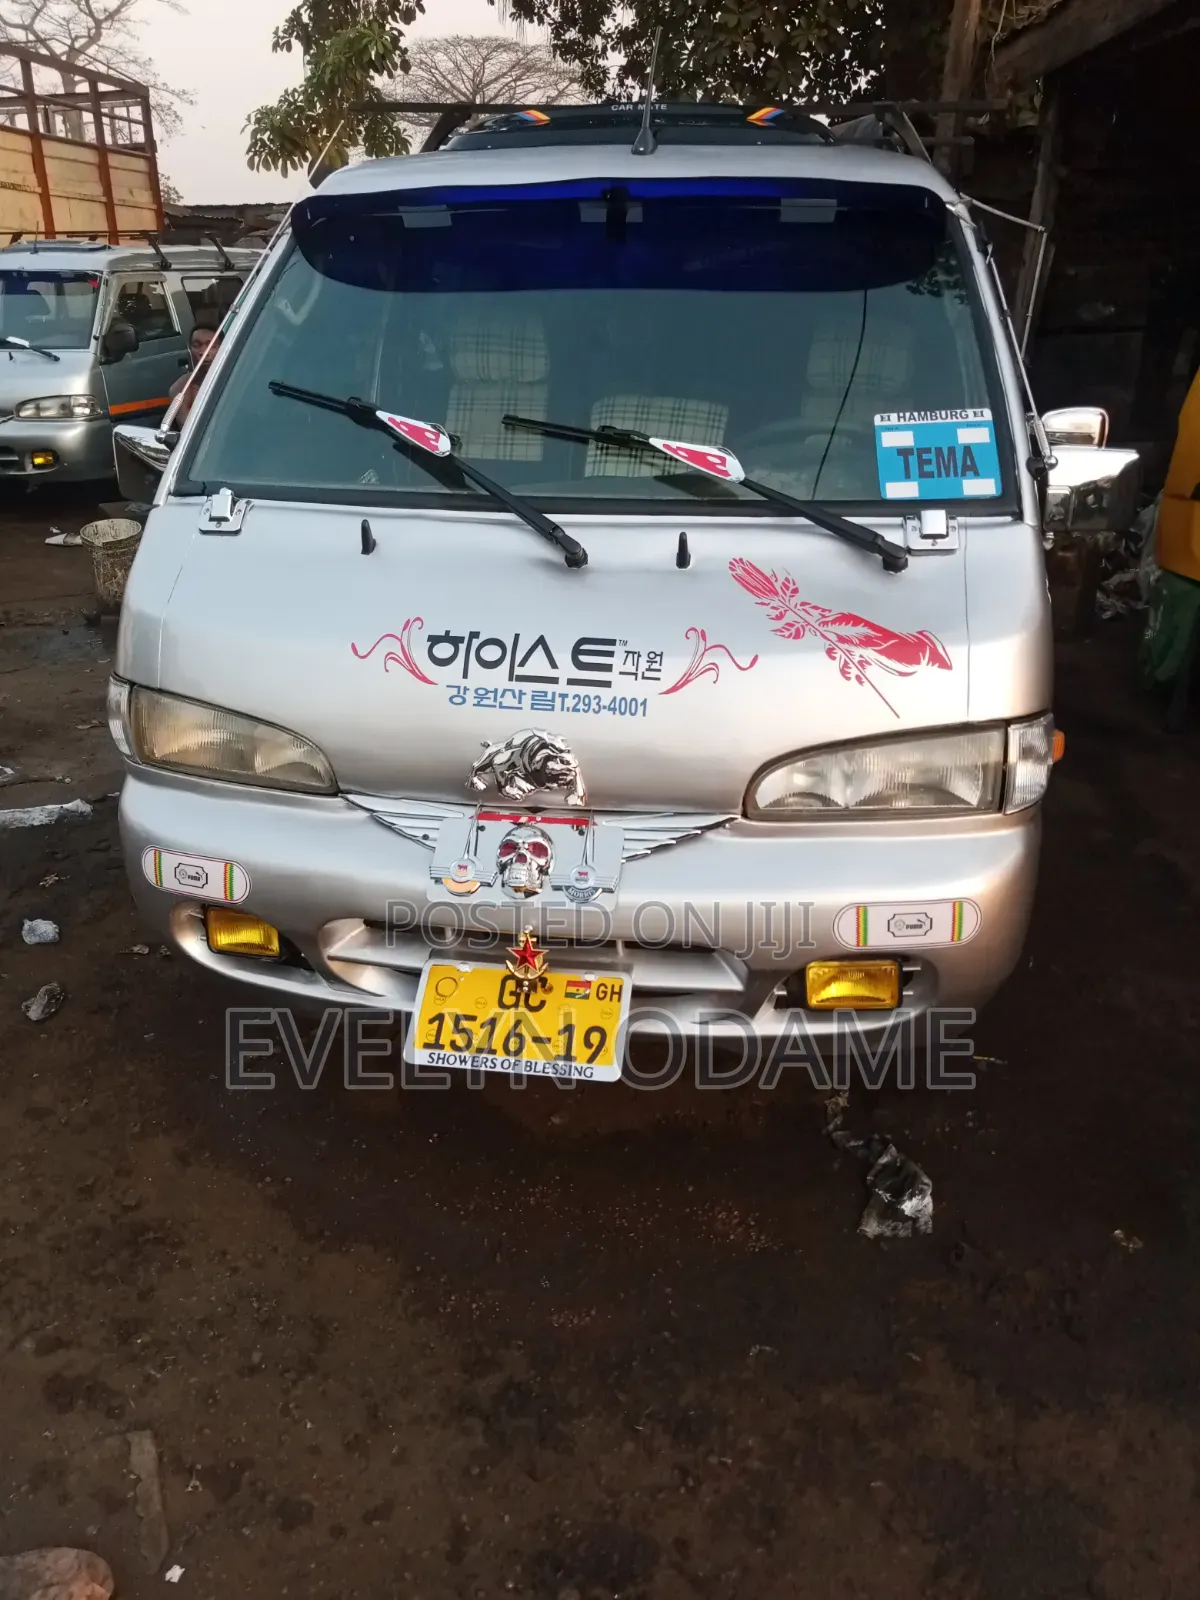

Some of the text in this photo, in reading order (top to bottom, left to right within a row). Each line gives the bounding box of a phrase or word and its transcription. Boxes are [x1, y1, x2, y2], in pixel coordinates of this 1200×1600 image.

[897, 409, 969, 422] HAMBURG
[896, 445, 981, 479] TEMA
[426, 630, 617, 688] 하이스트
[558, 693, 648, 717] T.293-4001
[497, 974, 548, 1013] GC
[596, 982, 623, 1003] GH
[422, 1012, 608, 1065] 1516-19
[427, 1051, 594, 1079] SHOWERS OF BLESSING
